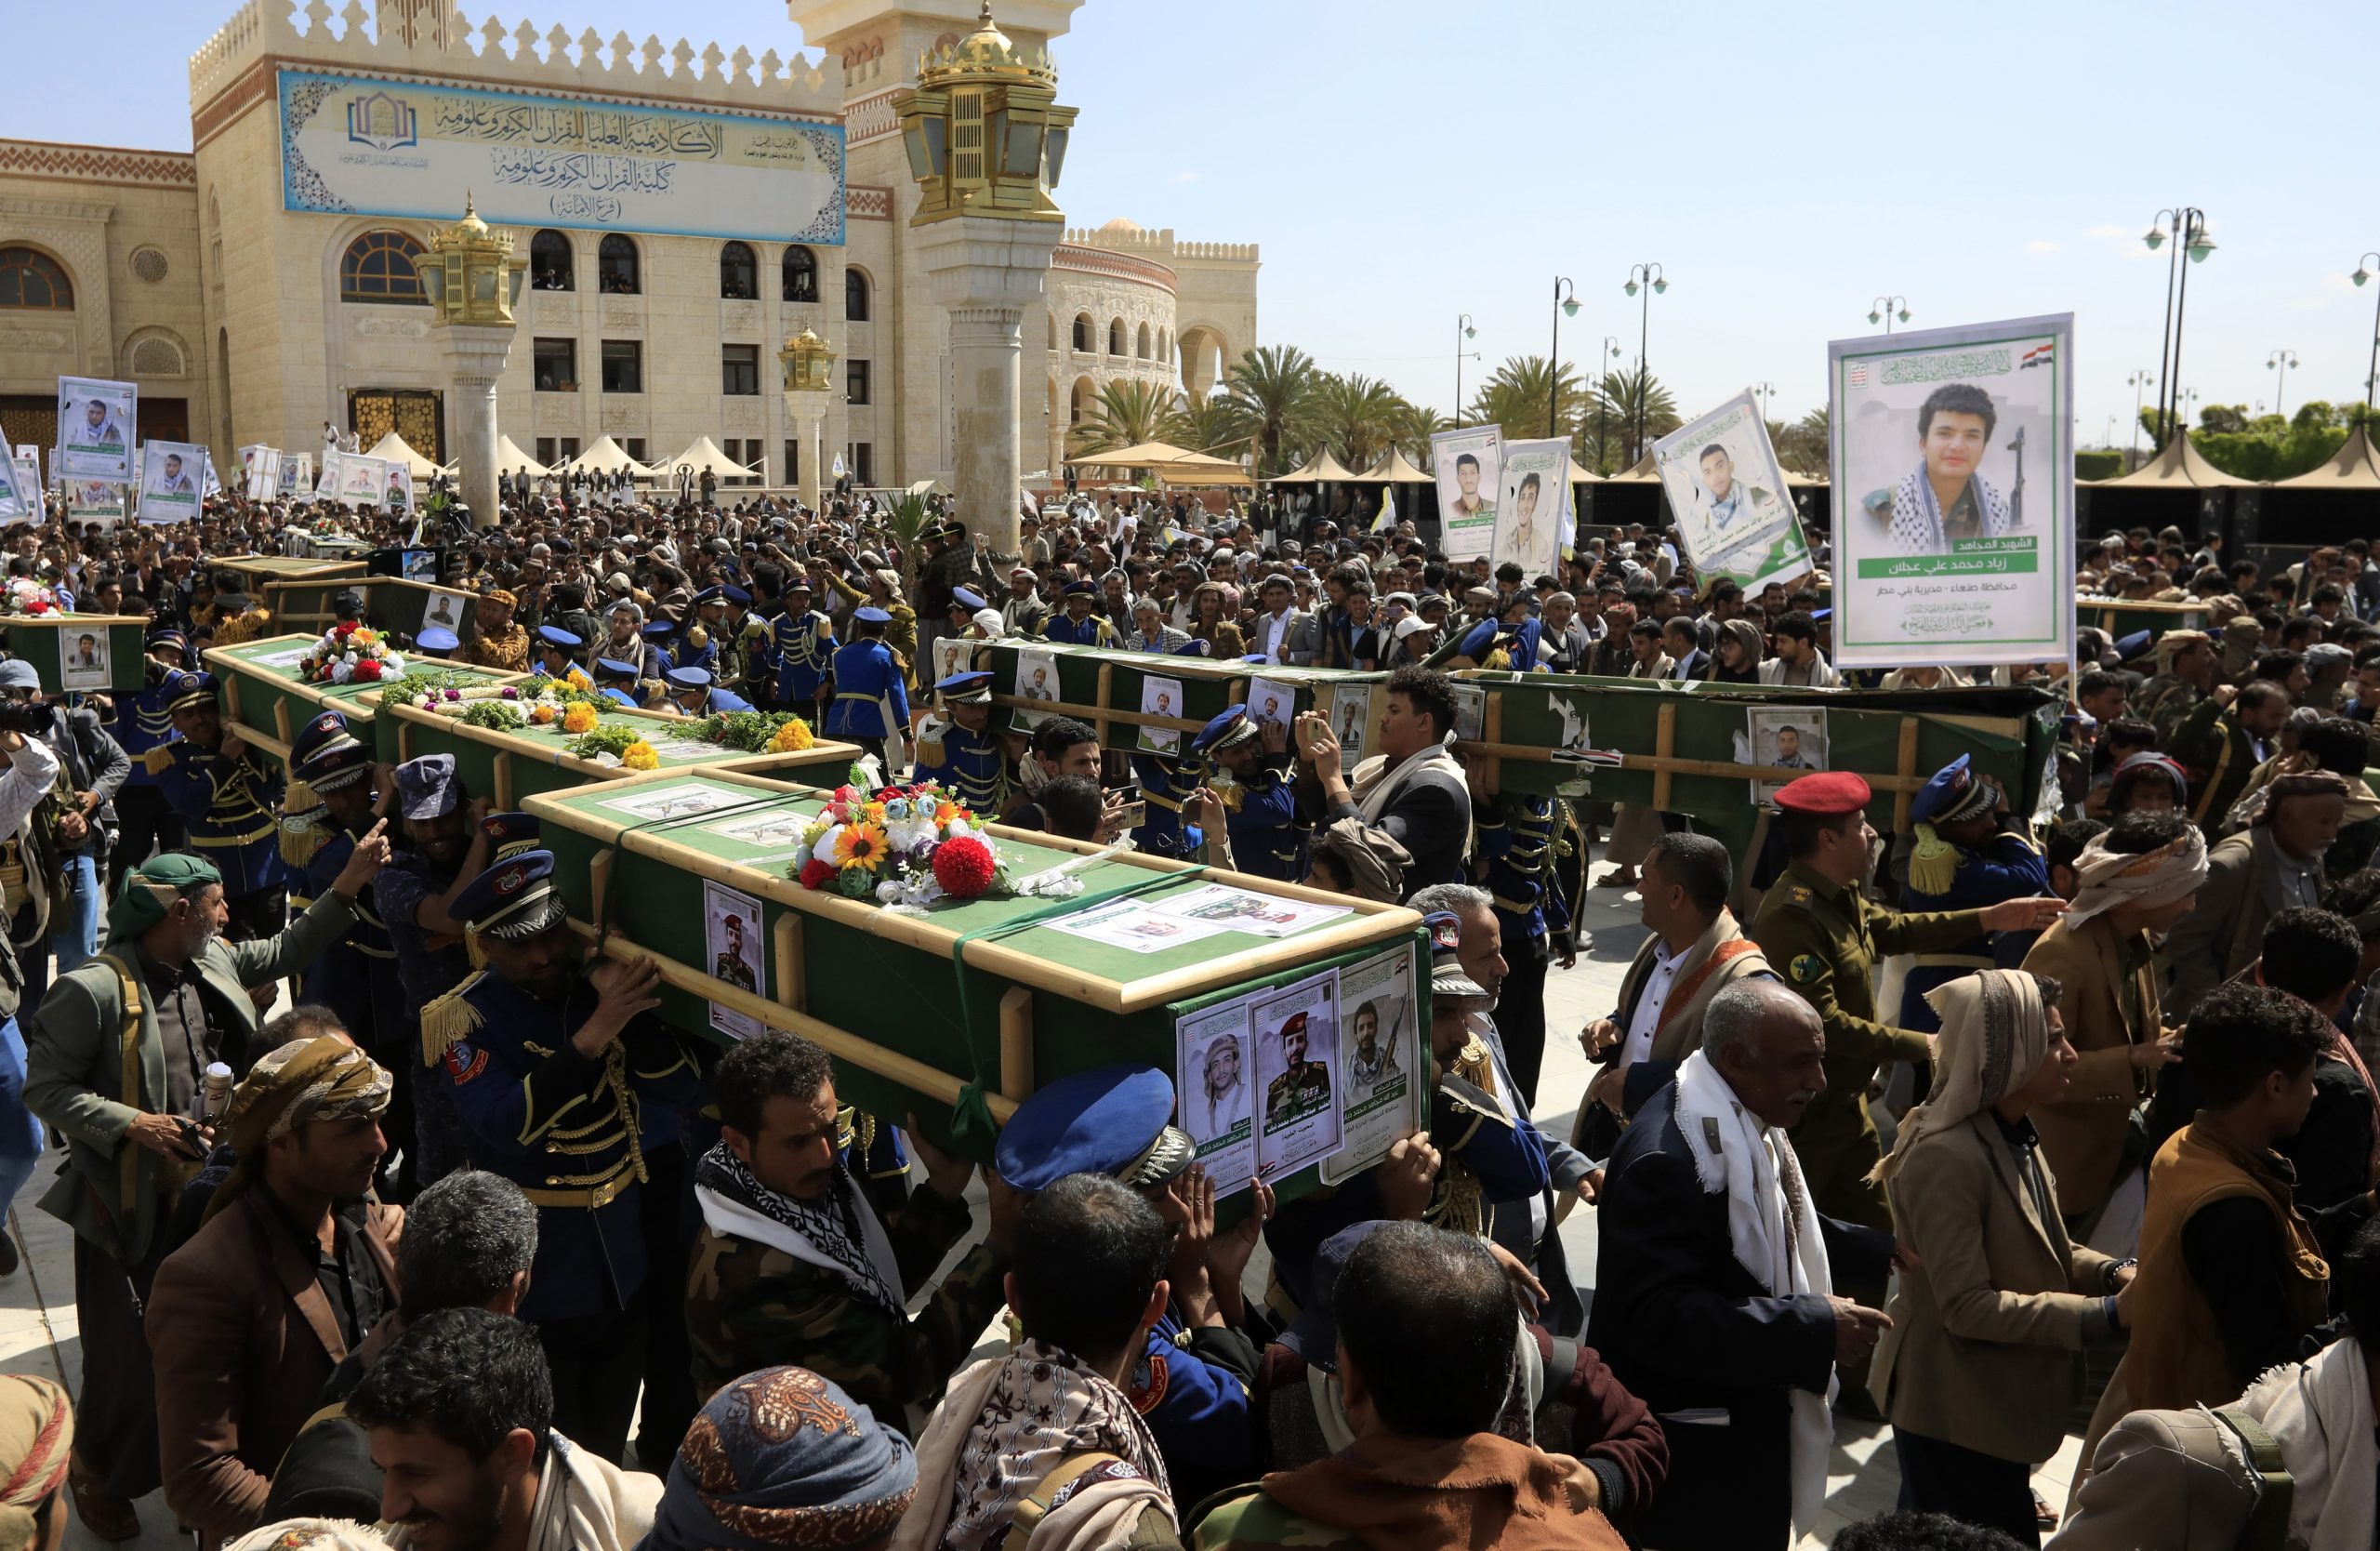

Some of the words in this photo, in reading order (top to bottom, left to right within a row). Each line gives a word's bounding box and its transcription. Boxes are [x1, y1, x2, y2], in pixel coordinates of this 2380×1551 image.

[483, 104, 537, 140] الكريم
[540, 152, 595, 190] الكريم
[634, 159, 676, 193] كلية
[1958, 539, 1998, 551] المجاهد
[2000, 537, 2033, 551] الشهيد
[1888, 561, 1921, 575] عجلان
[1924, 560, 1948, 576] علي
[1950, 559, 1984, 570] محمد
[1986, 556, 2007, 571] زياد
[1876, 585, 1896, 597] مطر
[1897, 585, 1914, 598] بني
[1913, 584, 1943, 596] مديرية
[1950, 582, 1979, 593] صنعاء
[1980, 581, 2018, 592] محافظة
[1375, 1081, 1391, 1093] المجاهد
[1368, 1097, 1383, 1108] مجاهد
[1353, 1105, 1368, 1116] محمد
[1233, 1118, 1250, 1130] المجاهد
[1277, 1119, 1289, 1129] محمد
[1212, 1140, 1226, 1149] محمد
[1226, 1133, 1242, 1144] مجاهد
